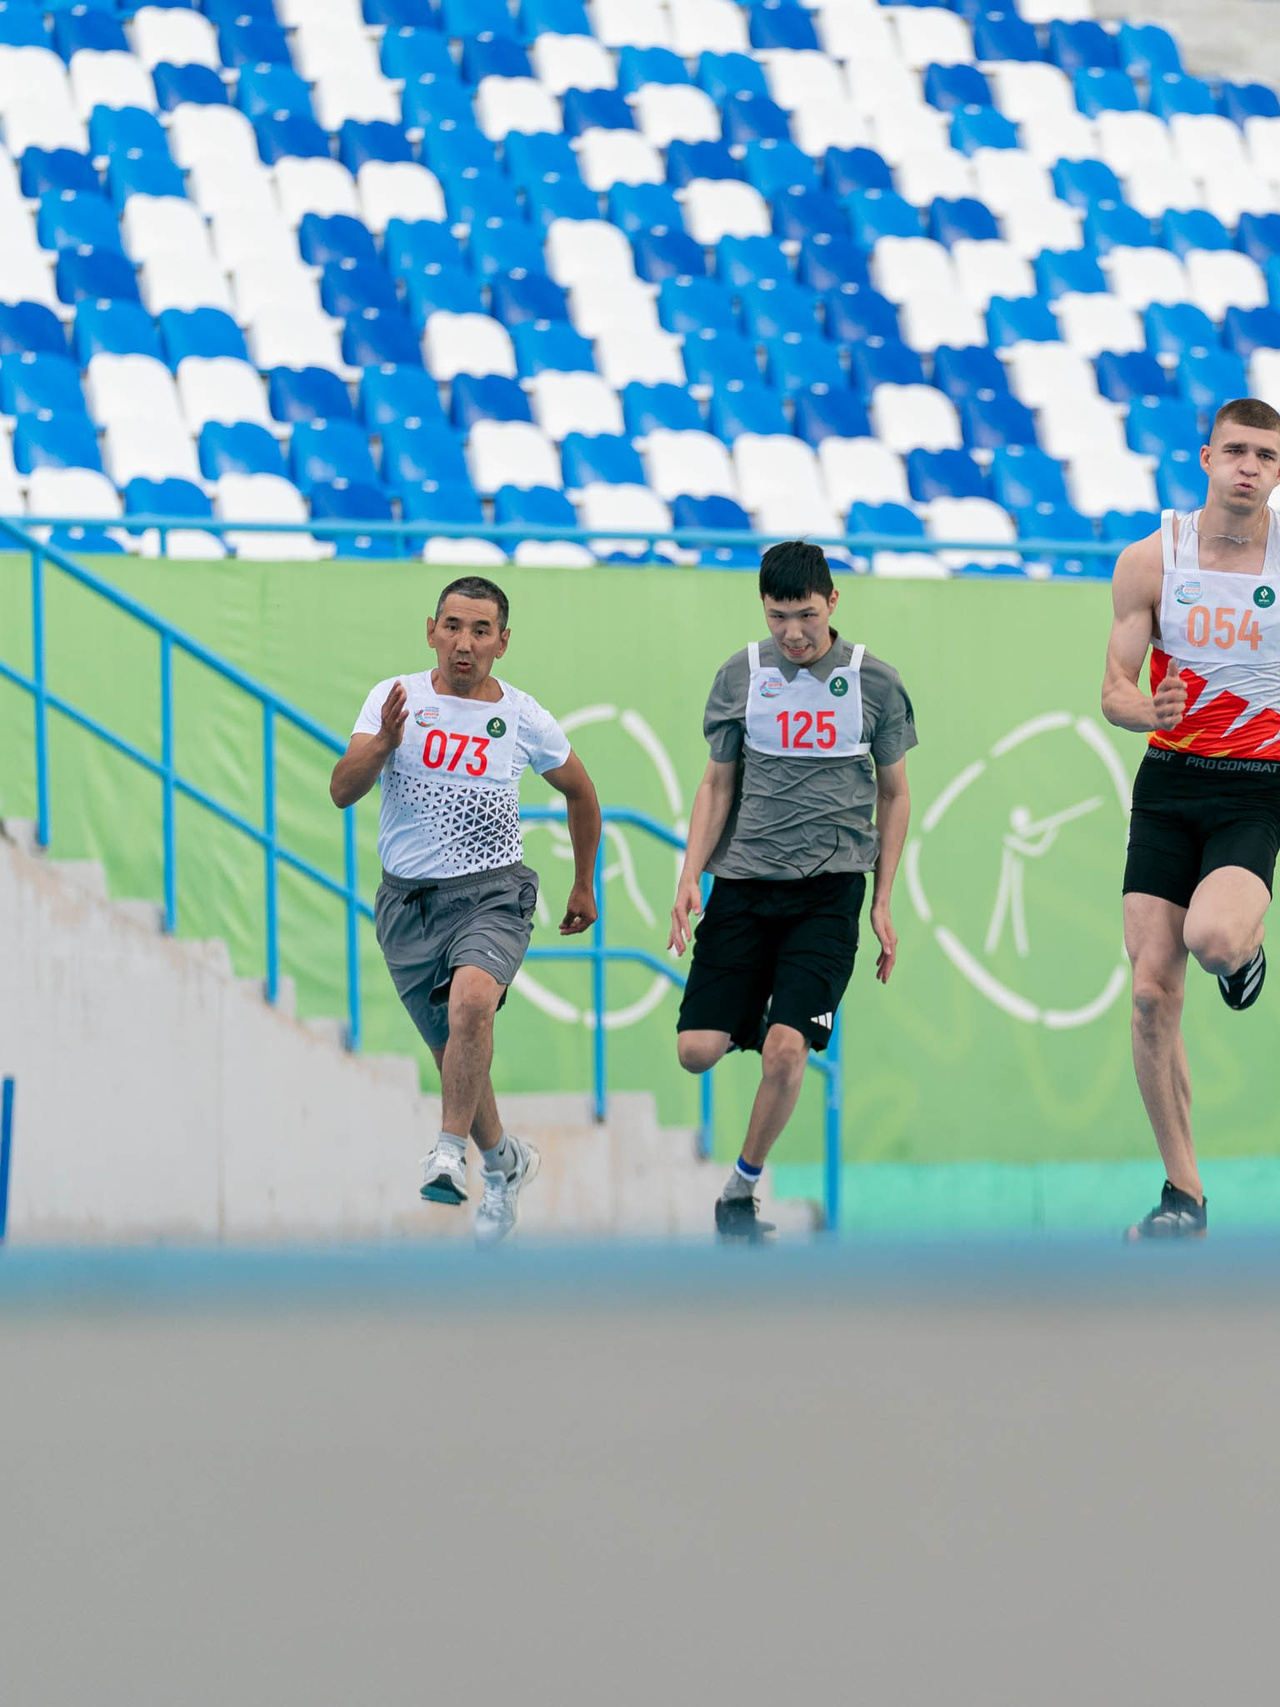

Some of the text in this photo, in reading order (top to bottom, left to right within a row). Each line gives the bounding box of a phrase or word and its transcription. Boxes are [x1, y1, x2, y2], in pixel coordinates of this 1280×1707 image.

[1187, 605, 1263, 651] 054
[776, 710, 837, 749] 125
[422, 729, 490, 777] 073
